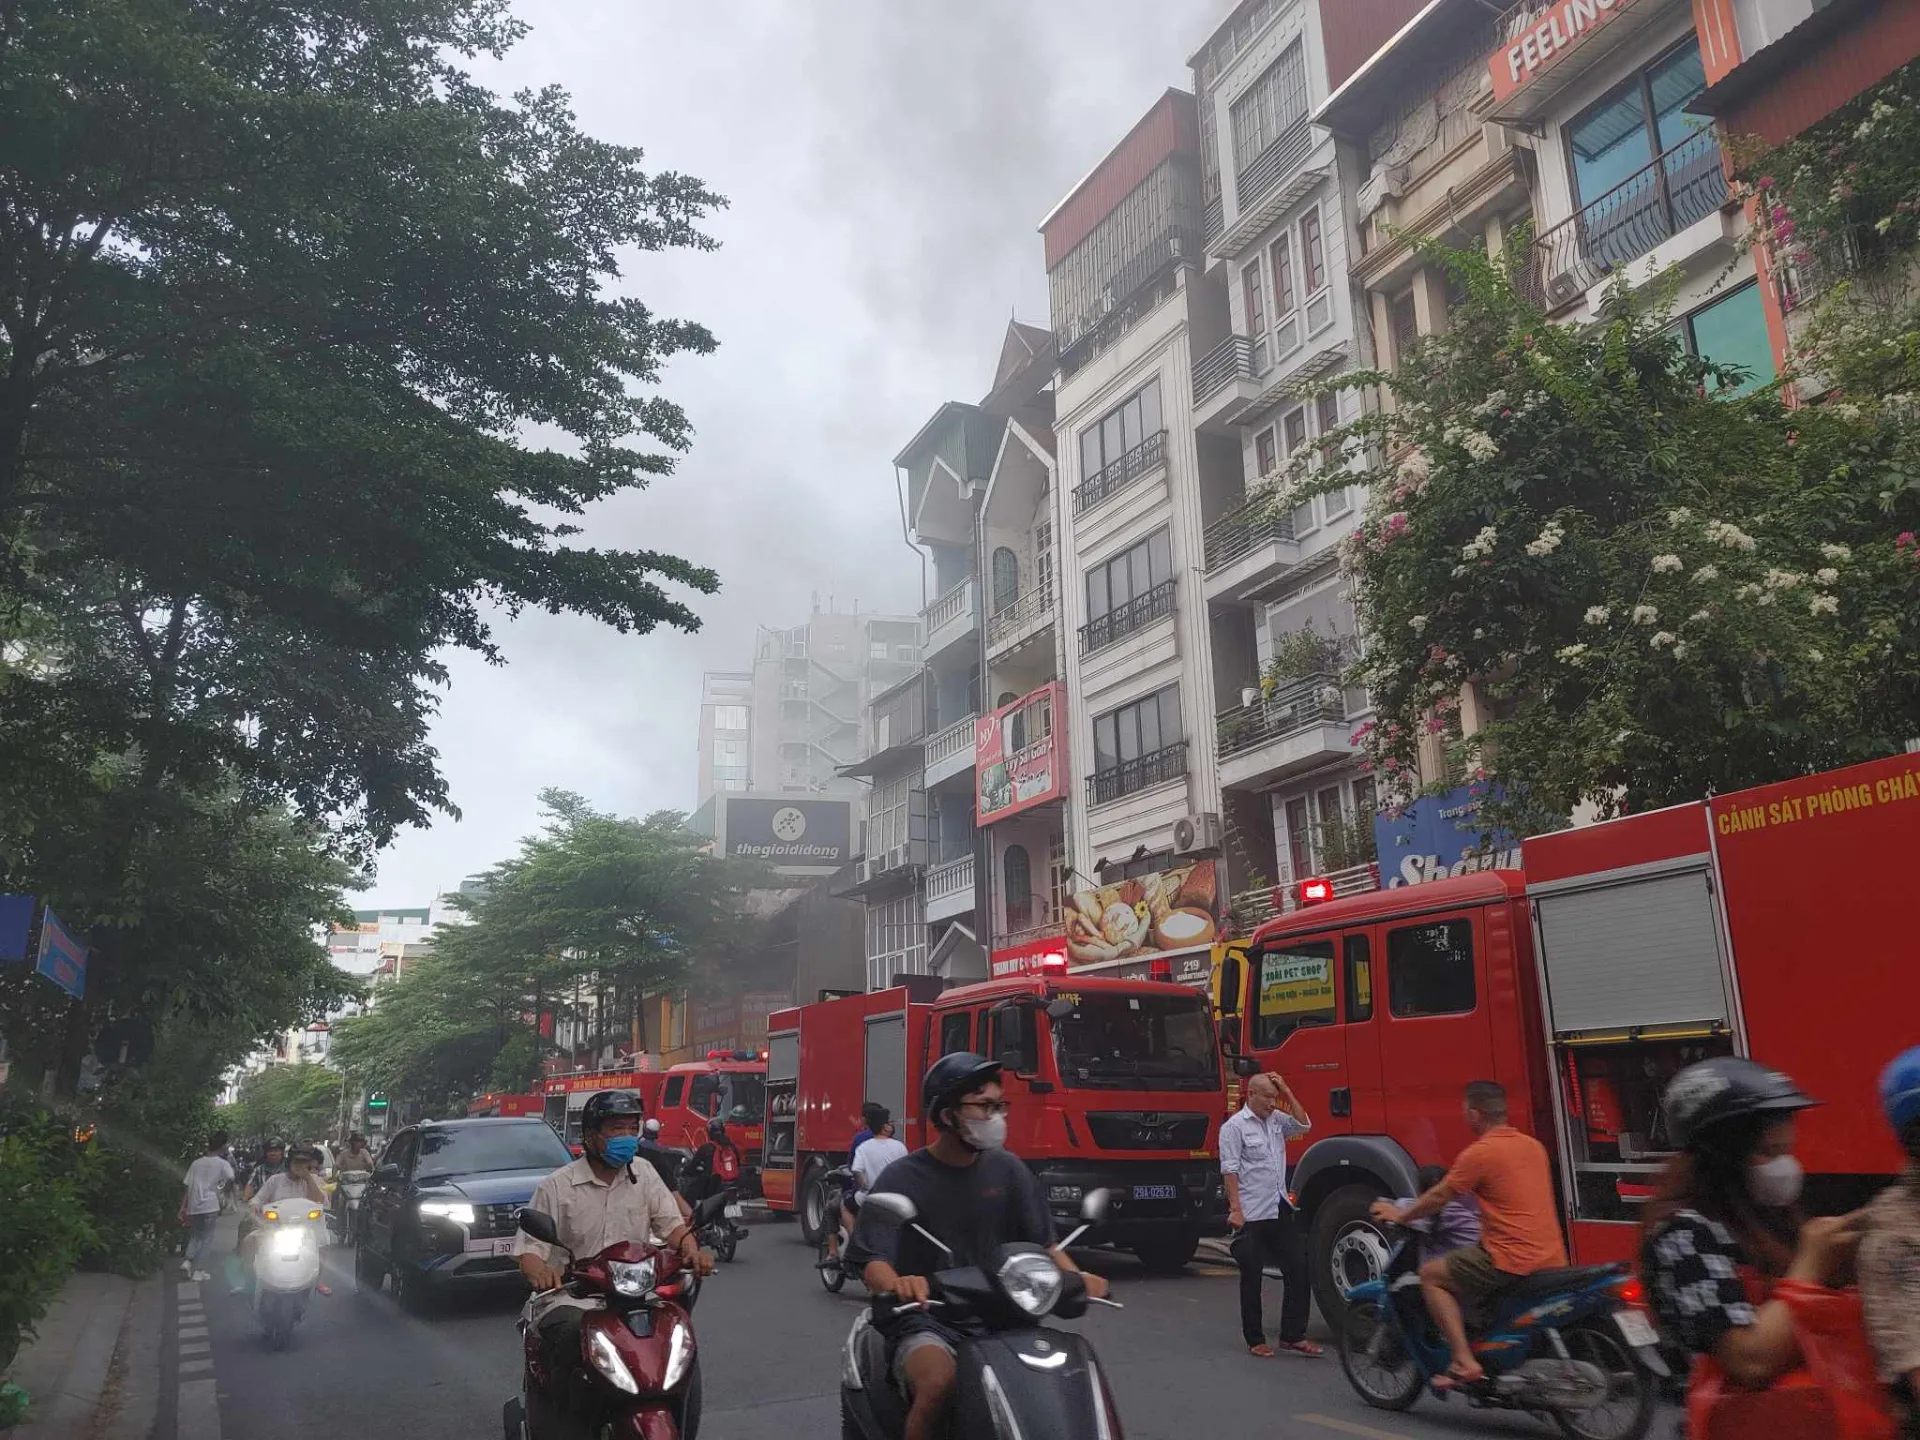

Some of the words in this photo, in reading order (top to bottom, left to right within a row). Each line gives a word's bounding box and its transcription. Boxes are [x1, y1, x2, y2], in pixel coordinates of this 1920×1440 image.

[1718, 804, 1767, 835] CẢNH
[1769, 795, 1802, 825] SÁT
[1806, 785, 1873, 817] PHÒNG
[736, 843, 840, 859] thegioididong
[1183, 959, 1200, 972] 219
[1284, 967, 1298, 978] PET
[1300, 964, 1322, 977] SHOP
